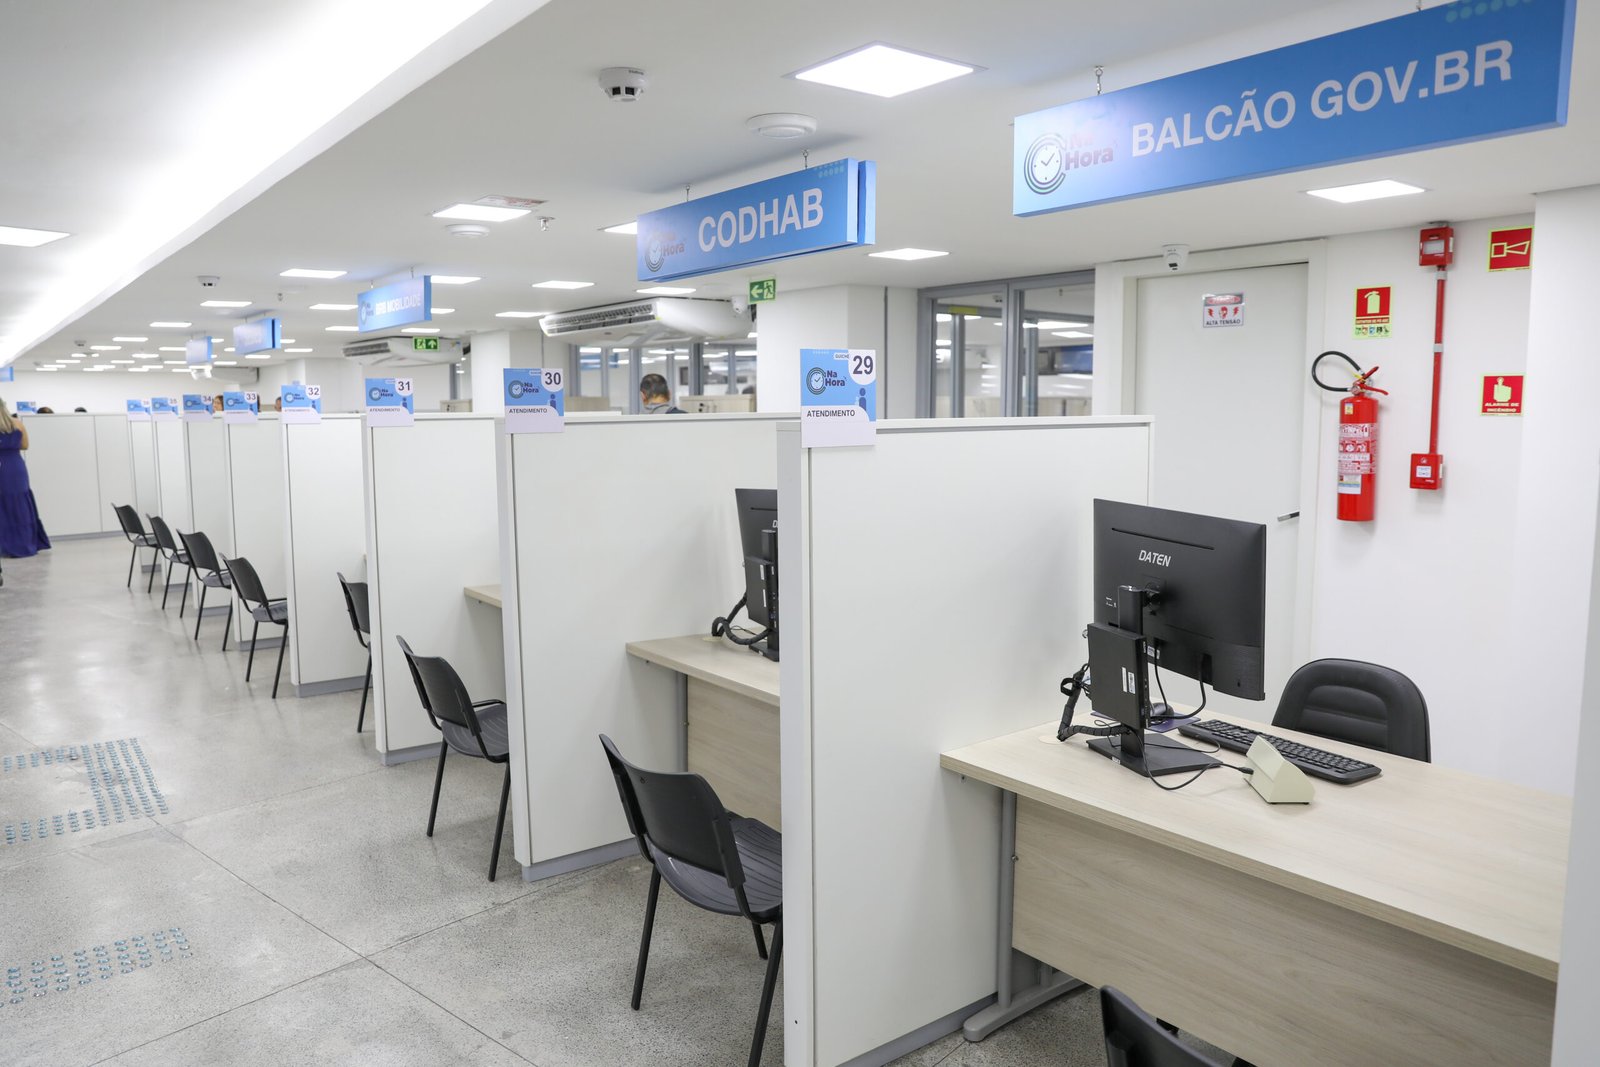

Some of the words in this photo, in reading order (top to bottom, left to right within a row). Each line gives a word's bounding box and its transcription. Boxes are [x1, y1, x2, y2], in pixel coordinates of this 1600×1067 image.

[1132, 88, 1296, 157] BALCÃO
[1311, 40, 1513, 119] GOV.BR
[1065, 147, 1114, 171] Hora
[698, 188, 824, 252] CODHAB
[852, 355, 874, 375] 29
[544, 372, 562, 386] 30
[826, 370, 838, 378] Na
[398, 381, 411, 392] 31
[825, 379, 846, 387] Hora
[246, 393, 256, 401] 33
[308, 387, 320, 396] 32
[806, 410, 856, 418] ATENDIMENTO
[1138, 549, 1172, 568] DATEN
